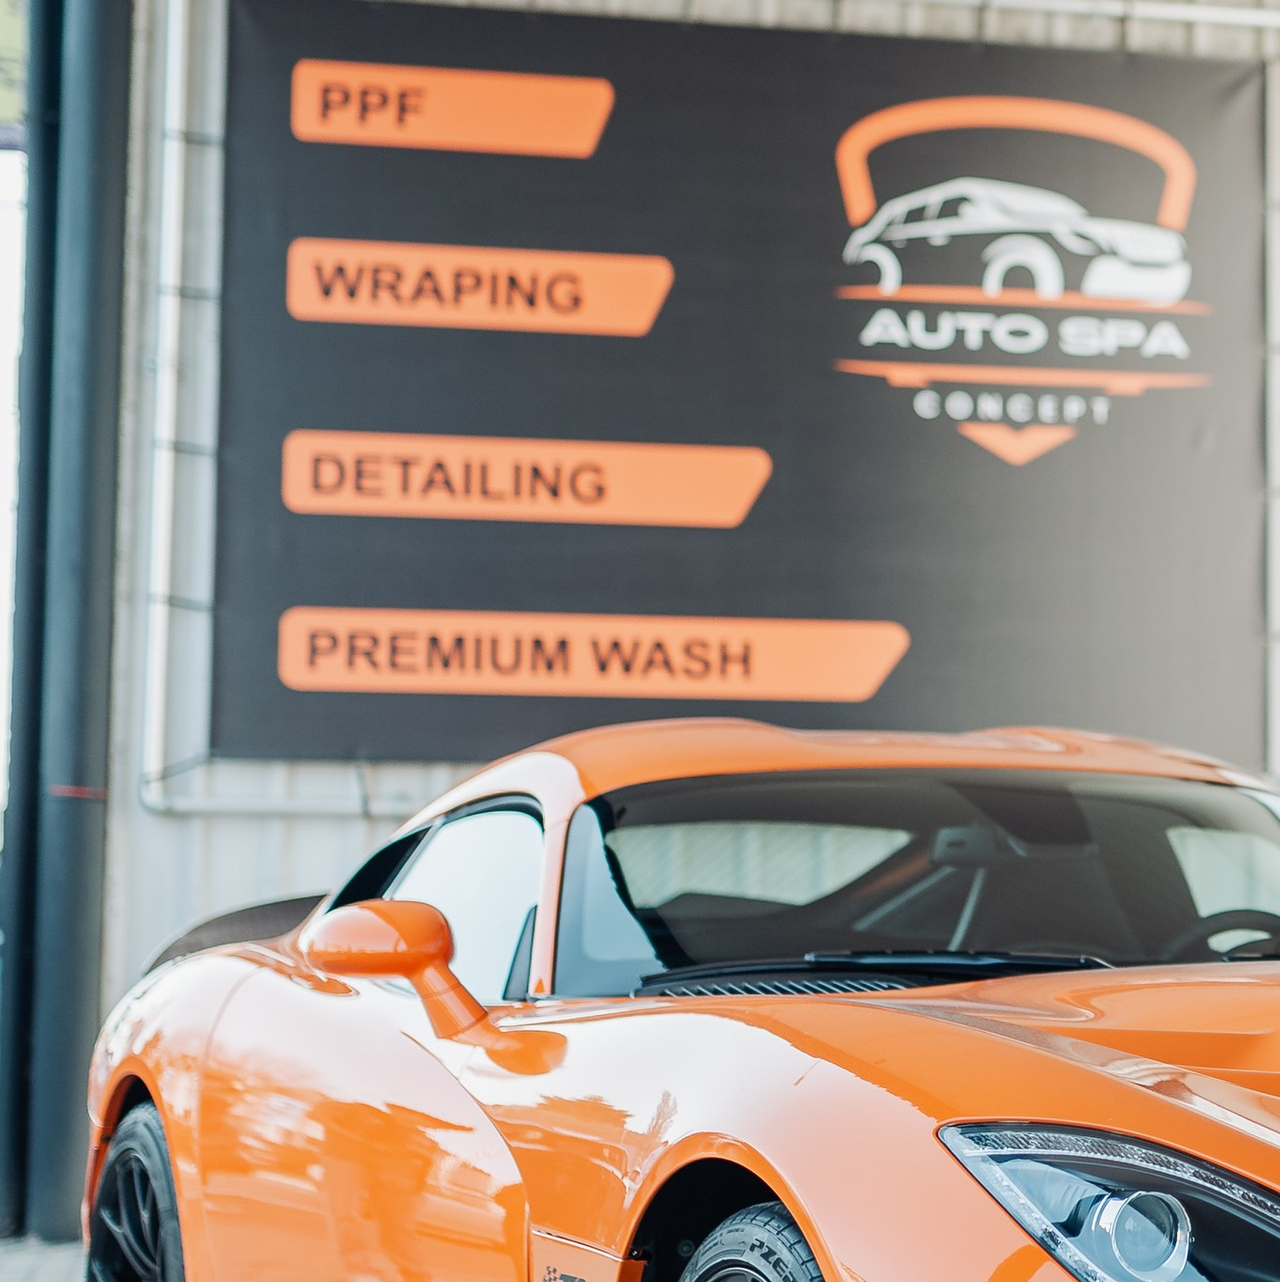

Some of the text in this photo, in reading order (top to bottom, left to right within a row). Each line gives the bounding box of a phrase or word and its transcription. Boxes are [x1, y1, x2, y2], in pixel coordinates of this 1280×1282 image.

[319, 83, 427, 126] PPF
[315, 262, 584, 314] WRAPING
[860, 308, 1191, 360] AUTO SPA
[913, 389, 1110, 425] CONCEPT
[311, 453, 607, 505] DETAILING
[307, 631, 754, 681] PREMIUM WASH
